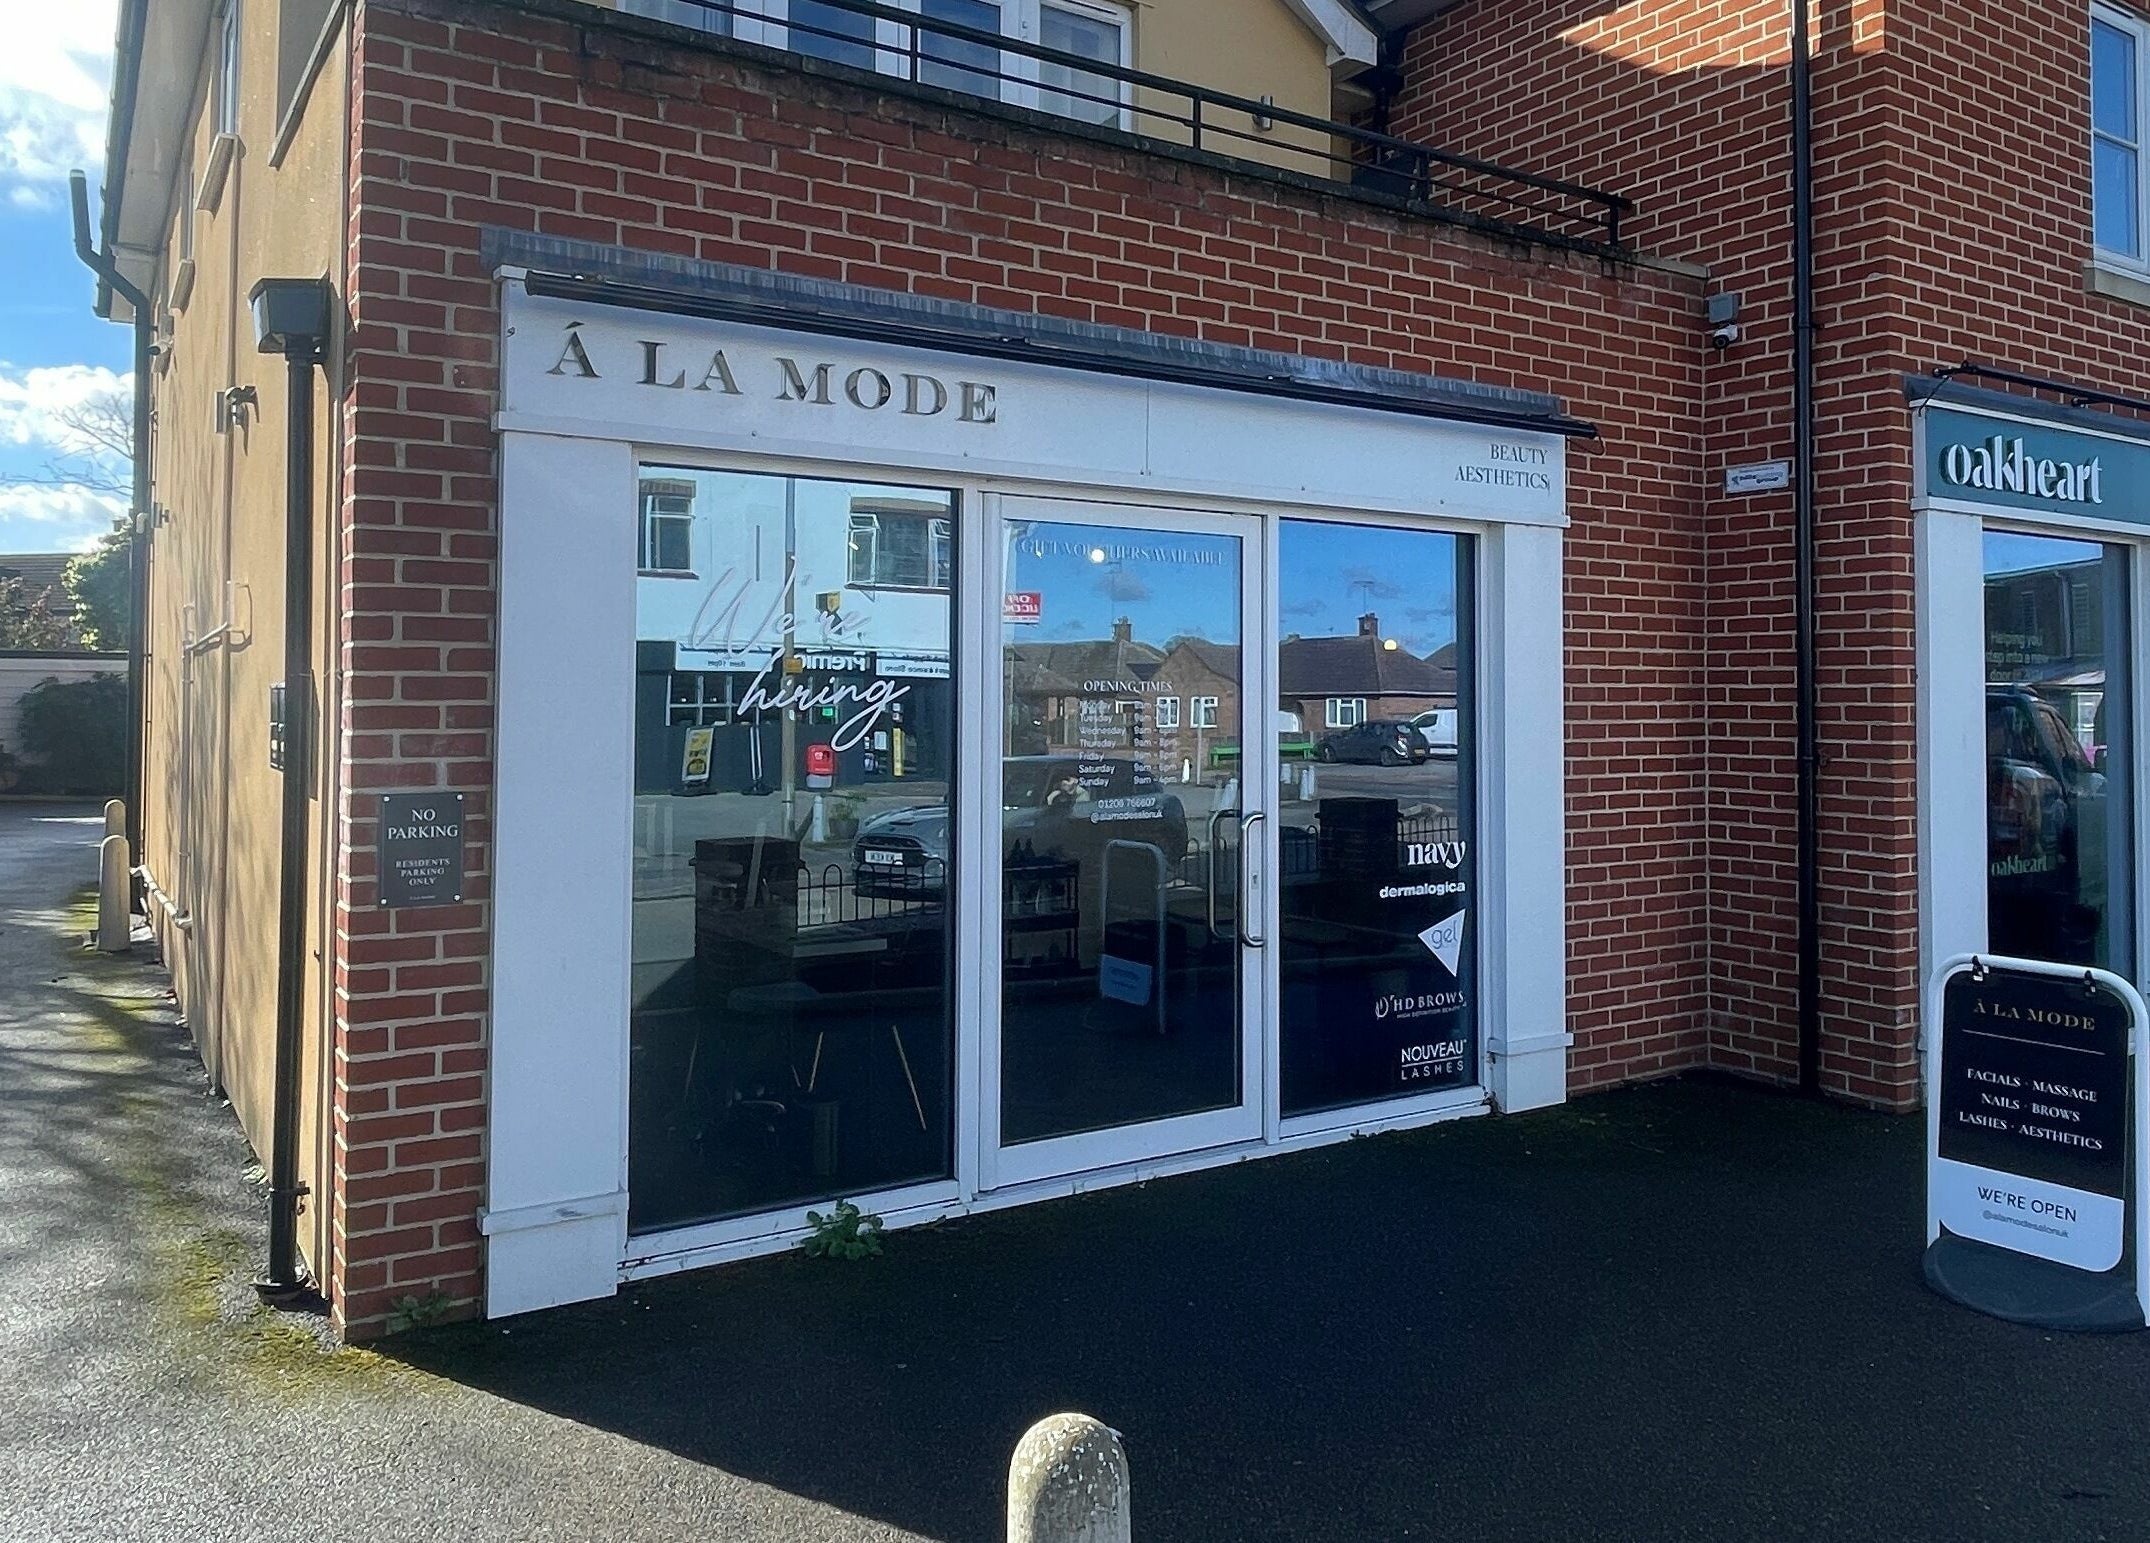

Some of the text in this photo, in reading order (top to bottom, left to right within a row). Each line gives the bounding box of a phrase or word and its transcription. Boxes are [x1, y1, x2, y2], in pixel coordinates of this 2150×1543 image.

[546, 321, 997, 424] Á LA MODE
[1490, 444, 1549, 465] BEAUTY
[1455, 465, 1550, 490] AESTHETICS
[1064, 542, 1151, 560] VOUHERS
[1084, 681, 1174, 694] OPENING TIMES
[737, 648, 911, 752] hiring
[1079, 726, 1126, 737] Wednesday
[1079, 738, 1116, 749] Thursday
[1079, 750, 1105, 762] Friday
[1079, 764, 1115, 775] Saturday
[1079, 777, 1110, 787] Sunday
[412, 809, 436, 822] NO
[388, 824, 458, 840] PARKING
[396, 858, 451, 868] RESIDENTS
[1407, 841, 1466, 869] navy
[401, 867, 445, 877] PARKING
[409, 877, 437, 886] ONLY
[1380, 881, 1466, 898] dermalogica
[1431, 920, 1458, 949] gel
[1393, 991, 1464, 1012] HD BROWS
[1994, 1003, 2021, 1020] LA
[2027, 1008, 2096, 1031] MODE
[1401, 1039, 1464, 1063] NOUVEAU
[1401, 1060, 1464, 1080] LASHES
[1967, 1068, 2098, 1103] FACIALS MASSAGE
[1981, 1093, 2081, 1123] NAILS BROWS
[1959, 1111, 2103, 1151] LASHES AESTHETICS
[1977, 1186, 2077, 1223] WE'RE OPEN
